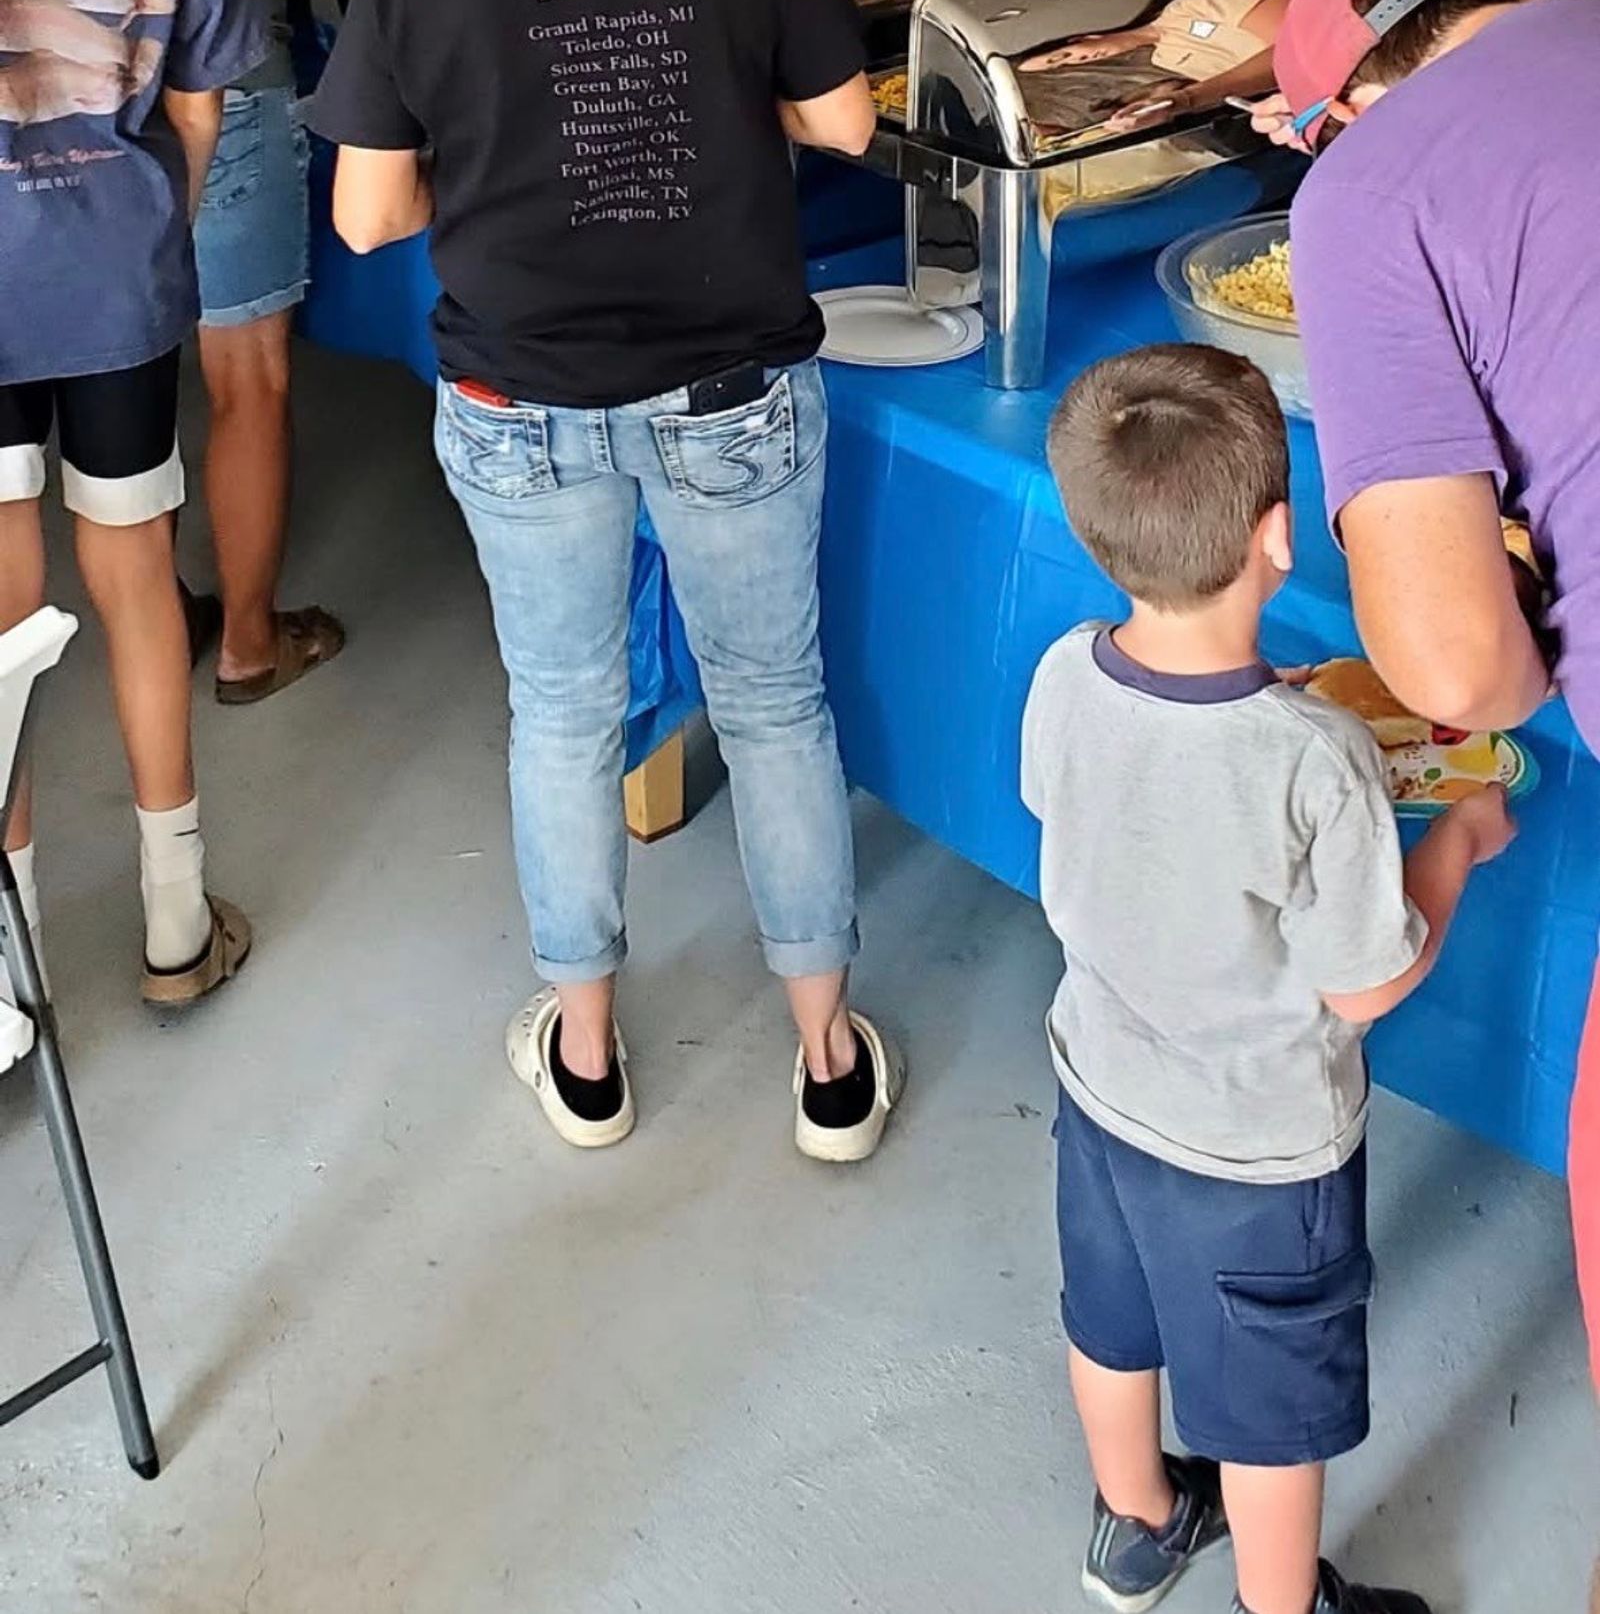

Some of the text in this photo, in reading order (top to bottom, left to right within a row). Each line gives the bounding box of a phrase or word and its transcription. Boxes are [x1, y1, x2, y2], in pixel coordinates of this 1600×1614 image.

[528, 5, 695, 40] Grand Rapids, MI
[561, 30, 669, 55] Toledo, OH
[551, 50, 688, 77] Sioux Falls, SD
[554, 70, 688, 96] Green Bay, WI
[573, 93, 676, 115] Duluth, GA
[562, 110, 692, 136] Huntsville, AL
[575, 130, 680, 156] Durant, OK
[562, 147, 697, 178] Fort Worth, TX
[648, 167, 675, 180] MS
[574, 185, 688, 211] Nashville, TN
[668, 205, 692, 219] KY
